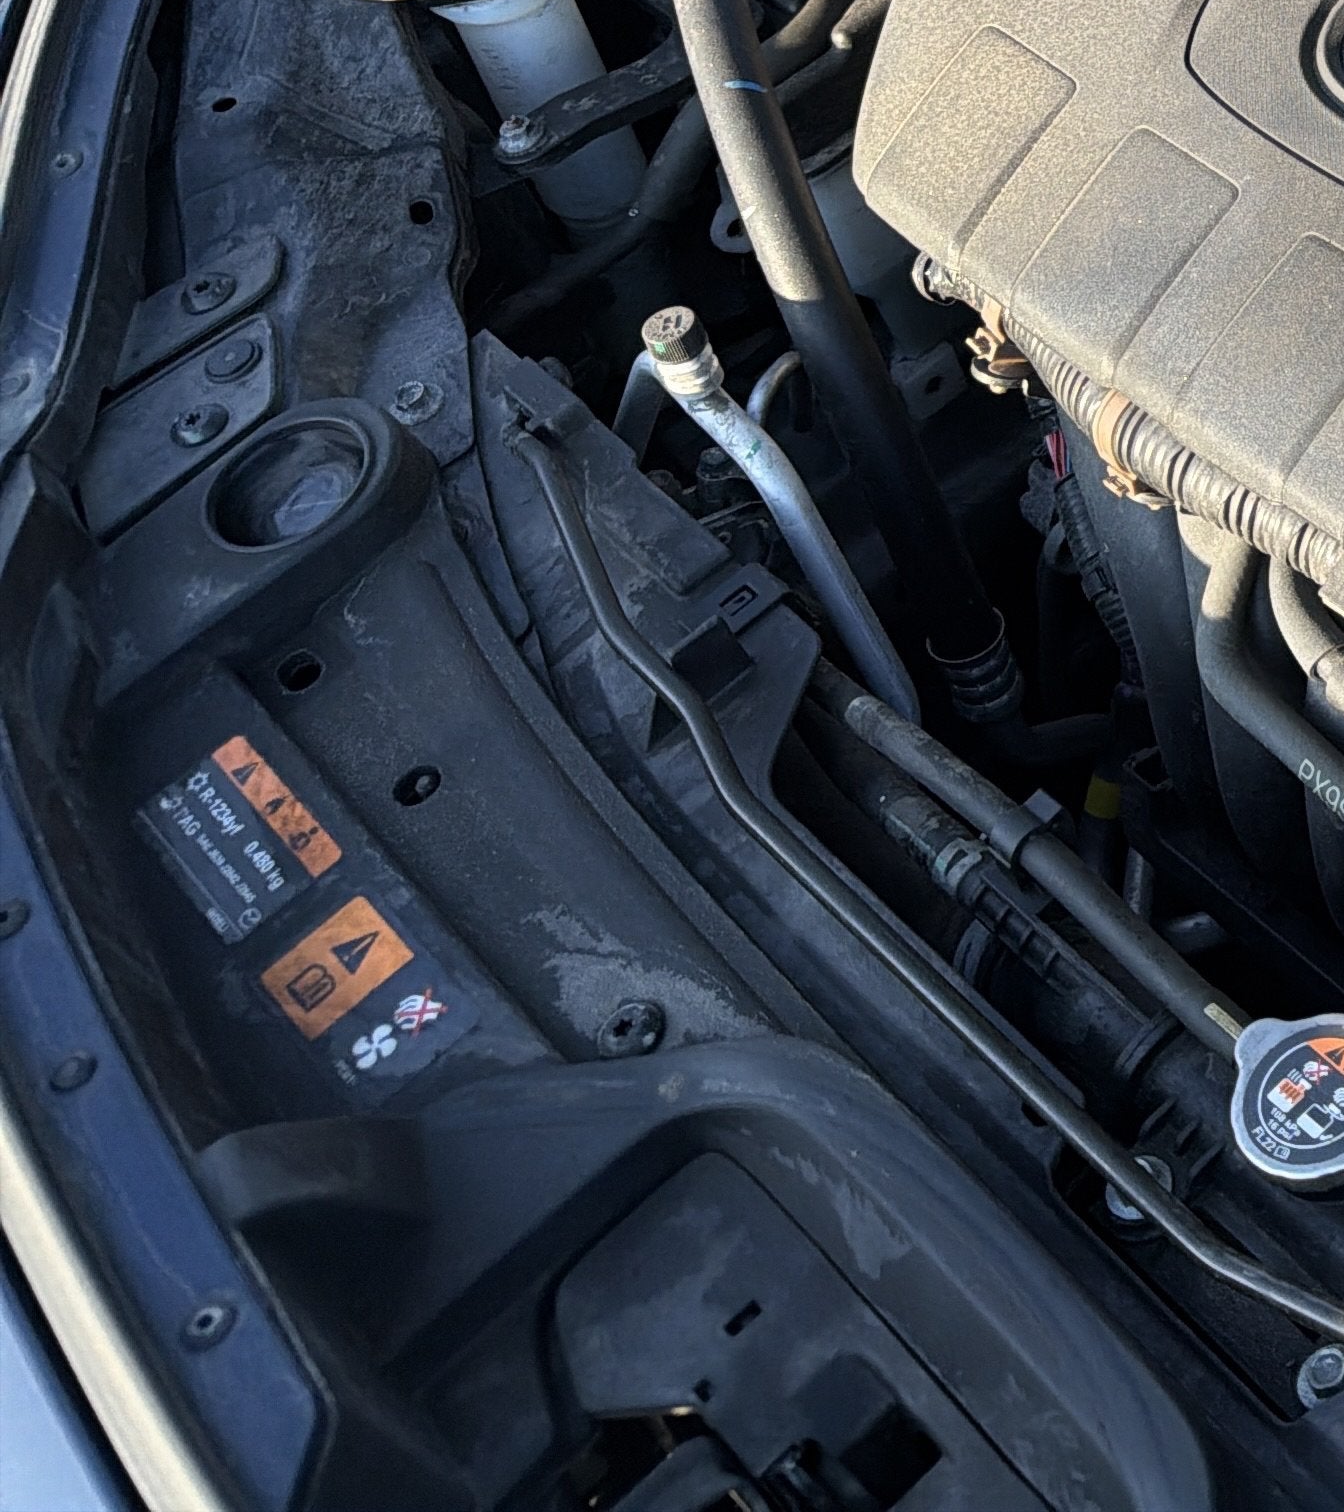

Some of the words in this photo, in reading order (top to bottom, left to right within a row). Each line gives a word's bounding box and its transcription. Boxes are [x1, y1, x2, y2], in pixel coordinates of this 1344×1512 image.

[197, 786, 245, 837] R-1234yf
[243, 839, 277, 874] 0.480
[266, 866, 285, 891] kg
[1250, 1125, 1277, 1153] FL22
